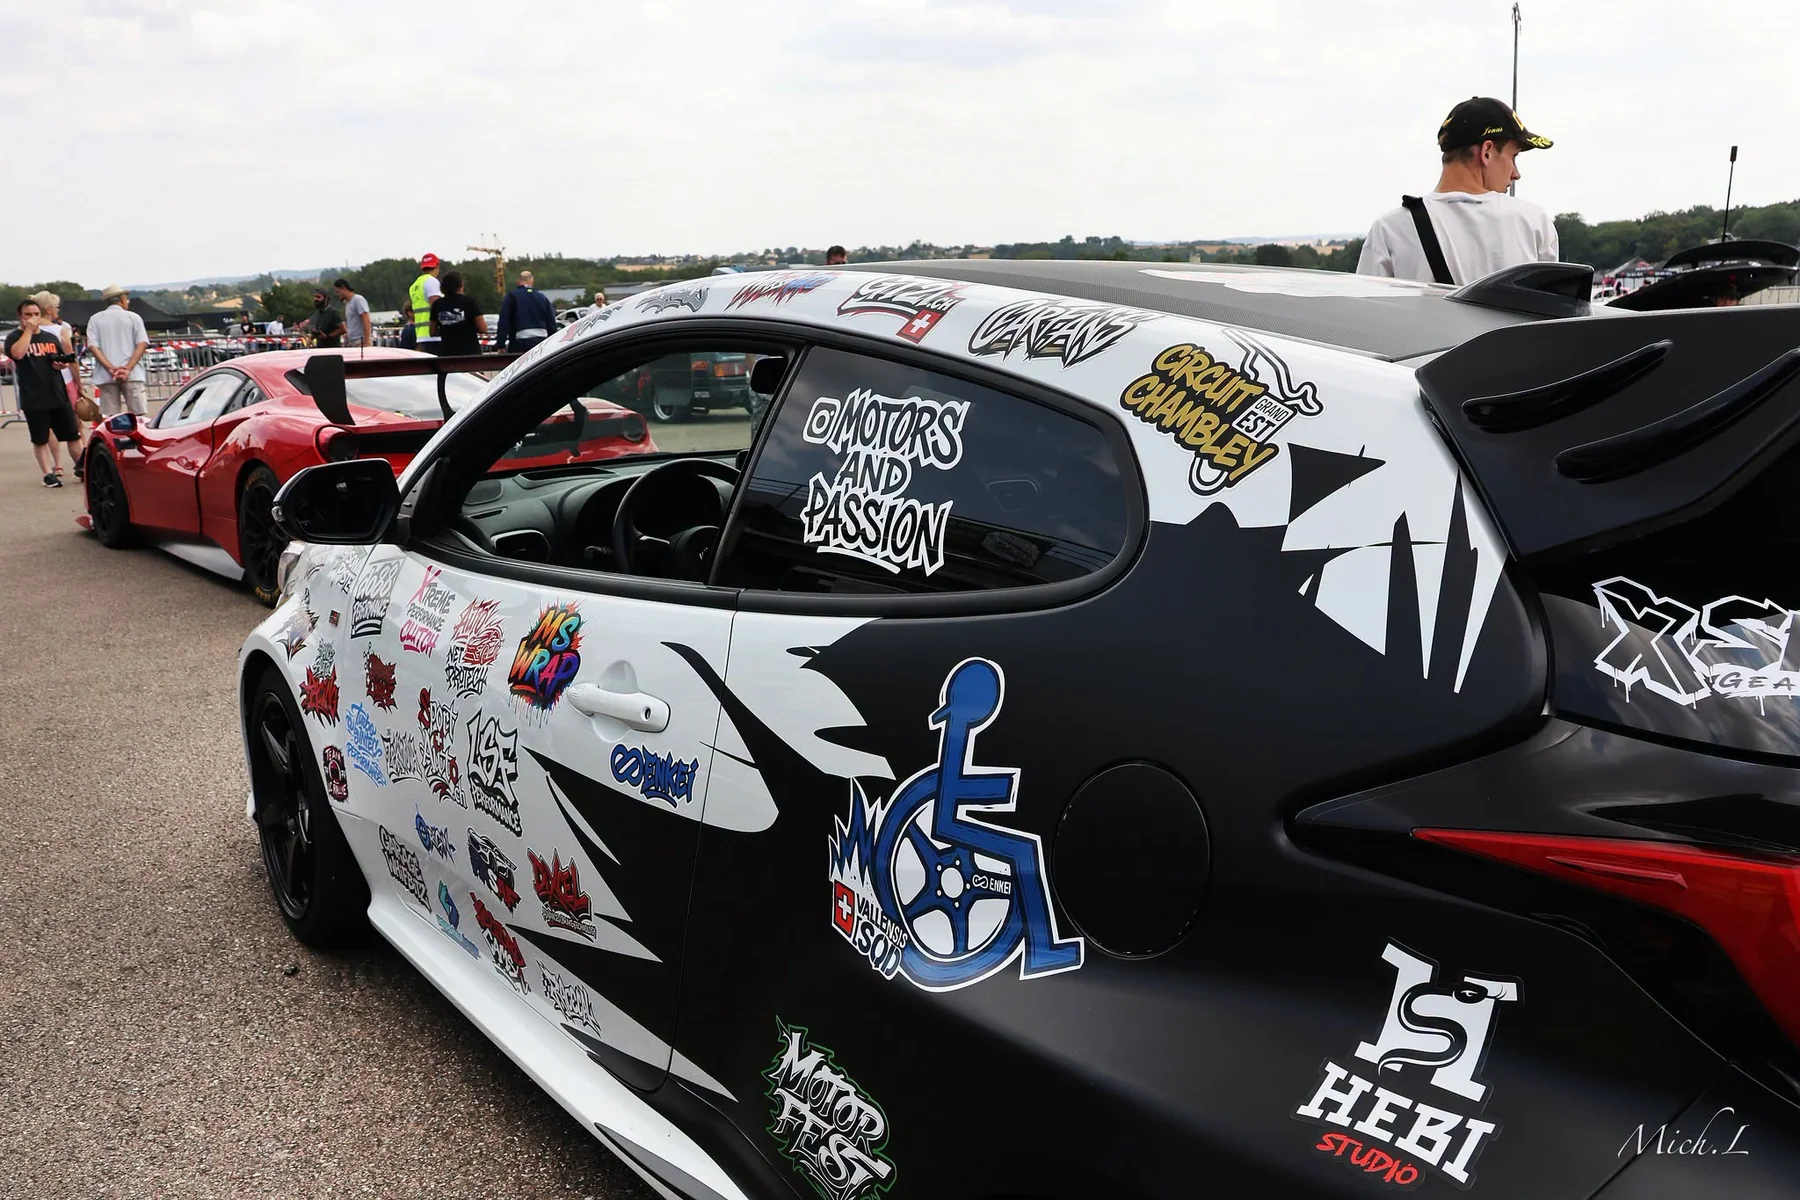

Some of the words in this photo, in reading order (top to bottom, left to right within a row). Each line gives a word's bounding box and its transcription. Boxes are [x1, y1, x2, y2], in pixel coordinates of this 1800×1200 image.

[827, 387, 971, 470] MOTORS
[1124, 375, 1275, 481] CHAMBLEY
[1235, 411, 1276, 439] EST
[1254, 398, 1288, 421] GRAND
[833, 450, 913, 498] AND
[800, 471, 953, 577] PASSION
[405, 564, 456, 614] XTREME
[399, 618, 439, 659] CLUTCH
[406, 602, 445, 632] PERFORMANCE
[530, 608, 580, 652] MS
[445, 645, 465, 664] NET
[445, 663, 487, 695] PROTECH
[508, 639, 580, 700] WRAP
[467, 707, 519, 806] LSF
[469, 782, 522, 836] PERFORMANCE
[378, 824, 422, 877] GARAGE
[989, 877, 1012, 895] ENKEI
[856, 893, 907, 949] VALLENSIS
[768, 1032, 884, 1157] MOTOR
[773, 1087, 892, 1190] FEST
[1296, 1061, 1495, 1184] HEBI
